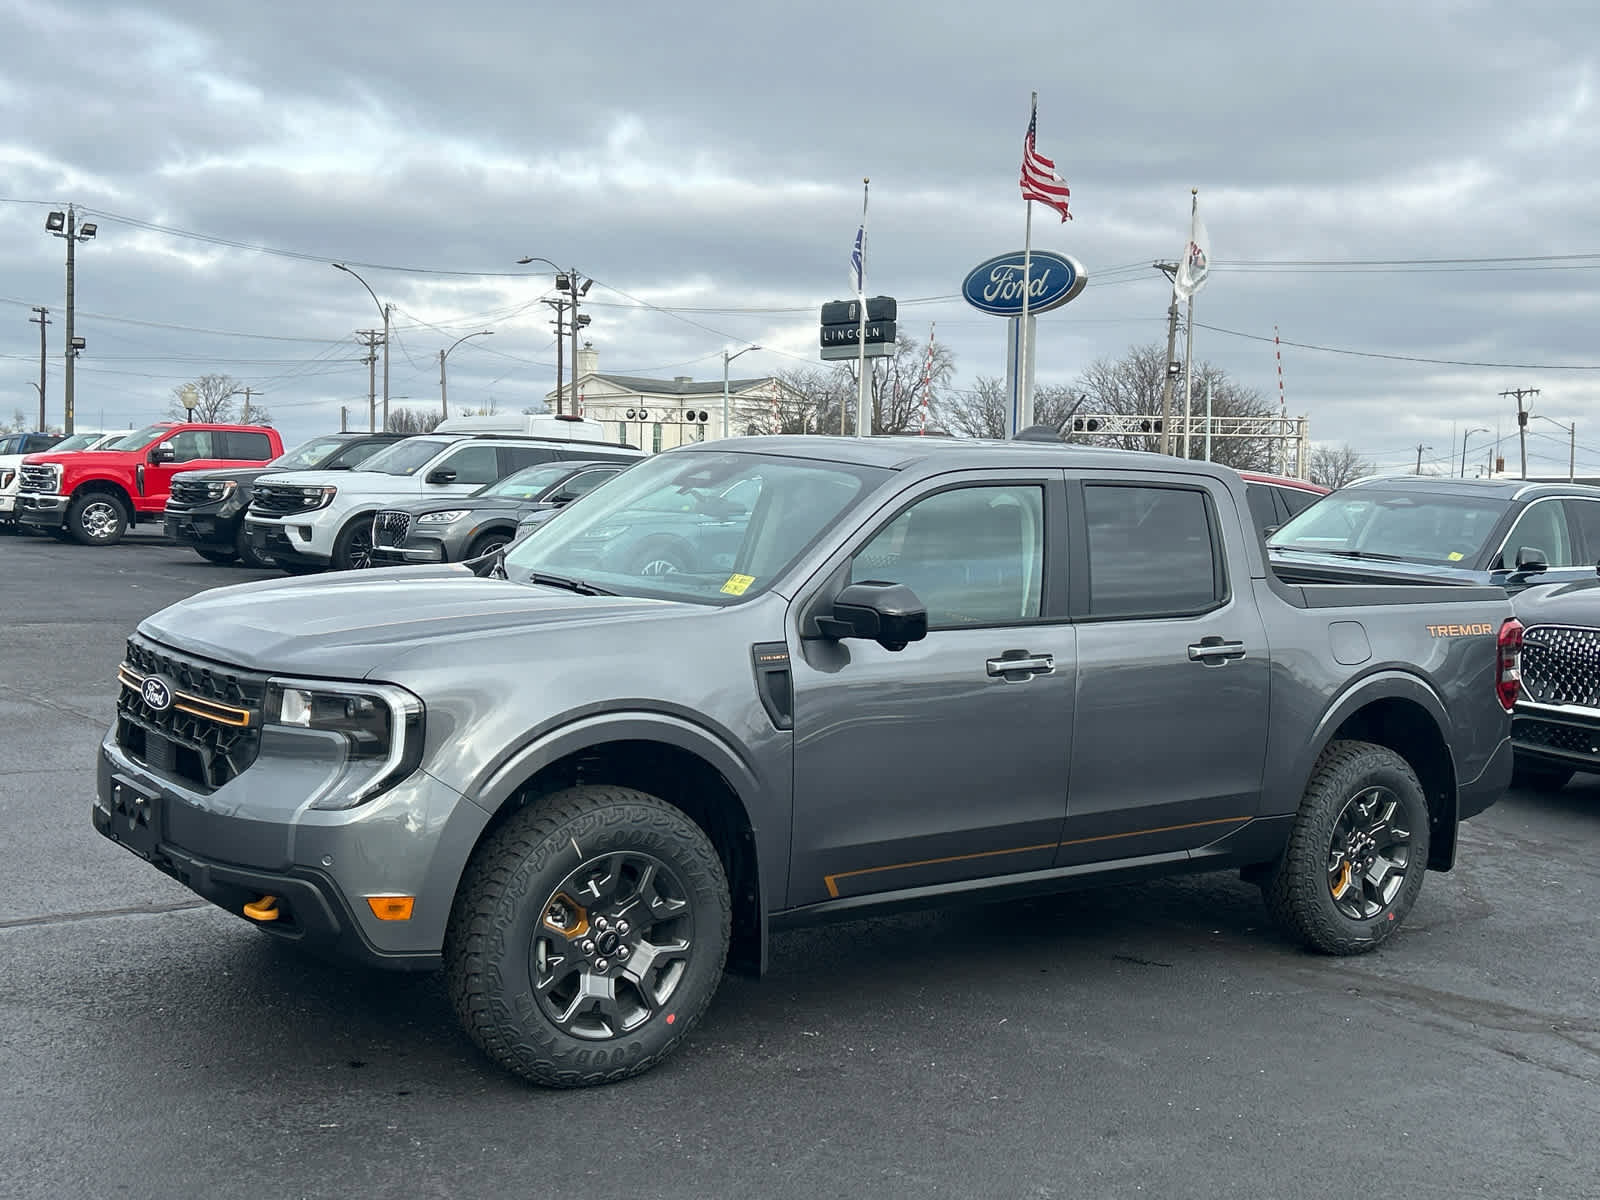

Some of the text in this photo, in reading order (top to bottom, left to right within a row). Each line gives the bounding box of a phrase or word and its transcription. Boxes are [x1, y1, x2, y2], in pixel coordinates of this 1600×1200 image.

[983, 262, 1050, 301] Ford
[824, 327, 880, 341] LINCOLN
[1426, 623, 1492, 637] TREMOR
